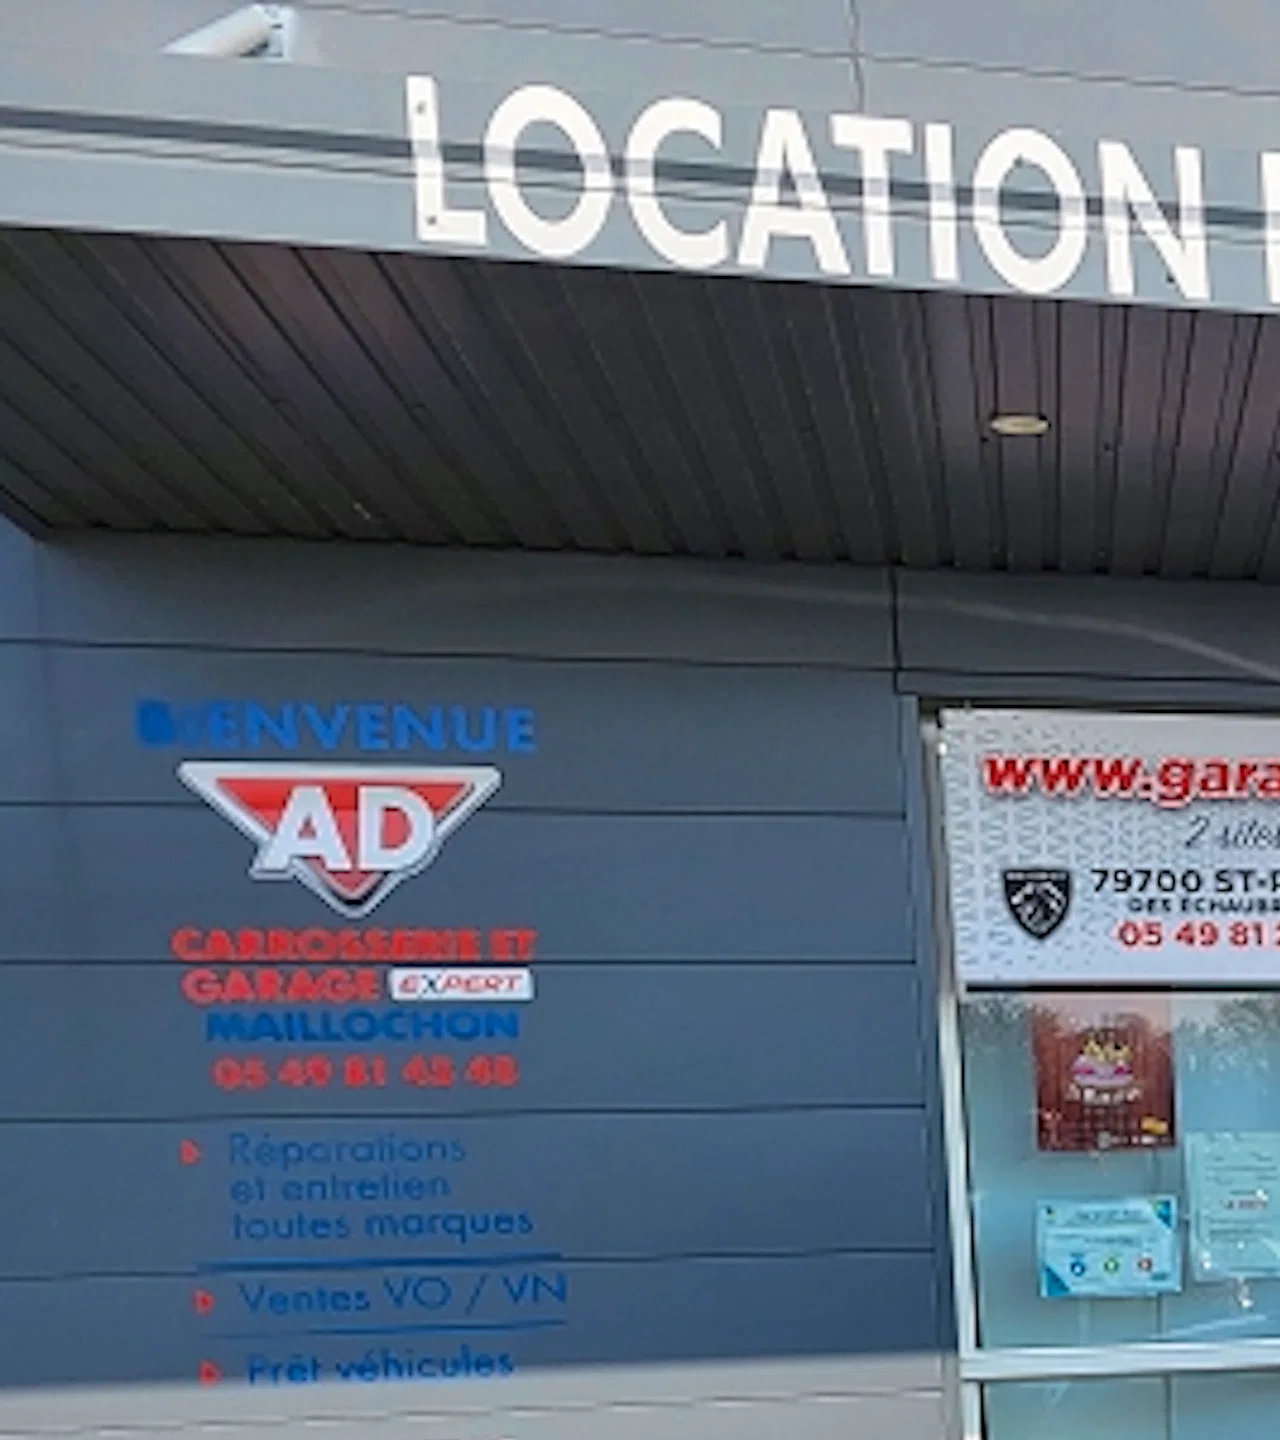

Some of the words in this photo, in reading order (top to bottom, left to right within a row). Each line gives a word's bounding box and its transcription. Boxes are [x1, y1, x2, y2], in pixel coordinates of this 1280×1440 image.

[406, 74, 1210, 303] LOCATION
[137, 696, 538, 753] BIENVENUE
[261, 785, 435, 871] AD
[1186, 815, 1211, 848] 2
[1091, 869, 1201, 893] 79700
[171, 928, 481, 961] CARROSSERIE
[488, 928, 538, 961] ET
[1117, 920, 1163, 947] 05
[1176, 920, 1219, 947] 49
[1228, 921, 1264, 947] 81
[181, 968, 383, 1006] GARAGE
[399, 974, 523, 995] EXPERT
[205, 1008, 521, 1042] MAILLOCHON
[229, 1132, 467, 1171] Réparations
[229, 1176, 266, 1202] et
[281, 1172, 452, 1202] entretien
[232, 1212, 351, 1240] toutes
[364, 1209, 535, 1244] marques
[237, 1282, 371, 1315] Ventes
[383, 1275, 453, 1310] VO
[464, 1274, 489, 1316] /
[501, 1272, 569, 1306] VN
[247, 1353, 323, 1386] Prêt
[336, 1344, 515, 1382] véhicules
